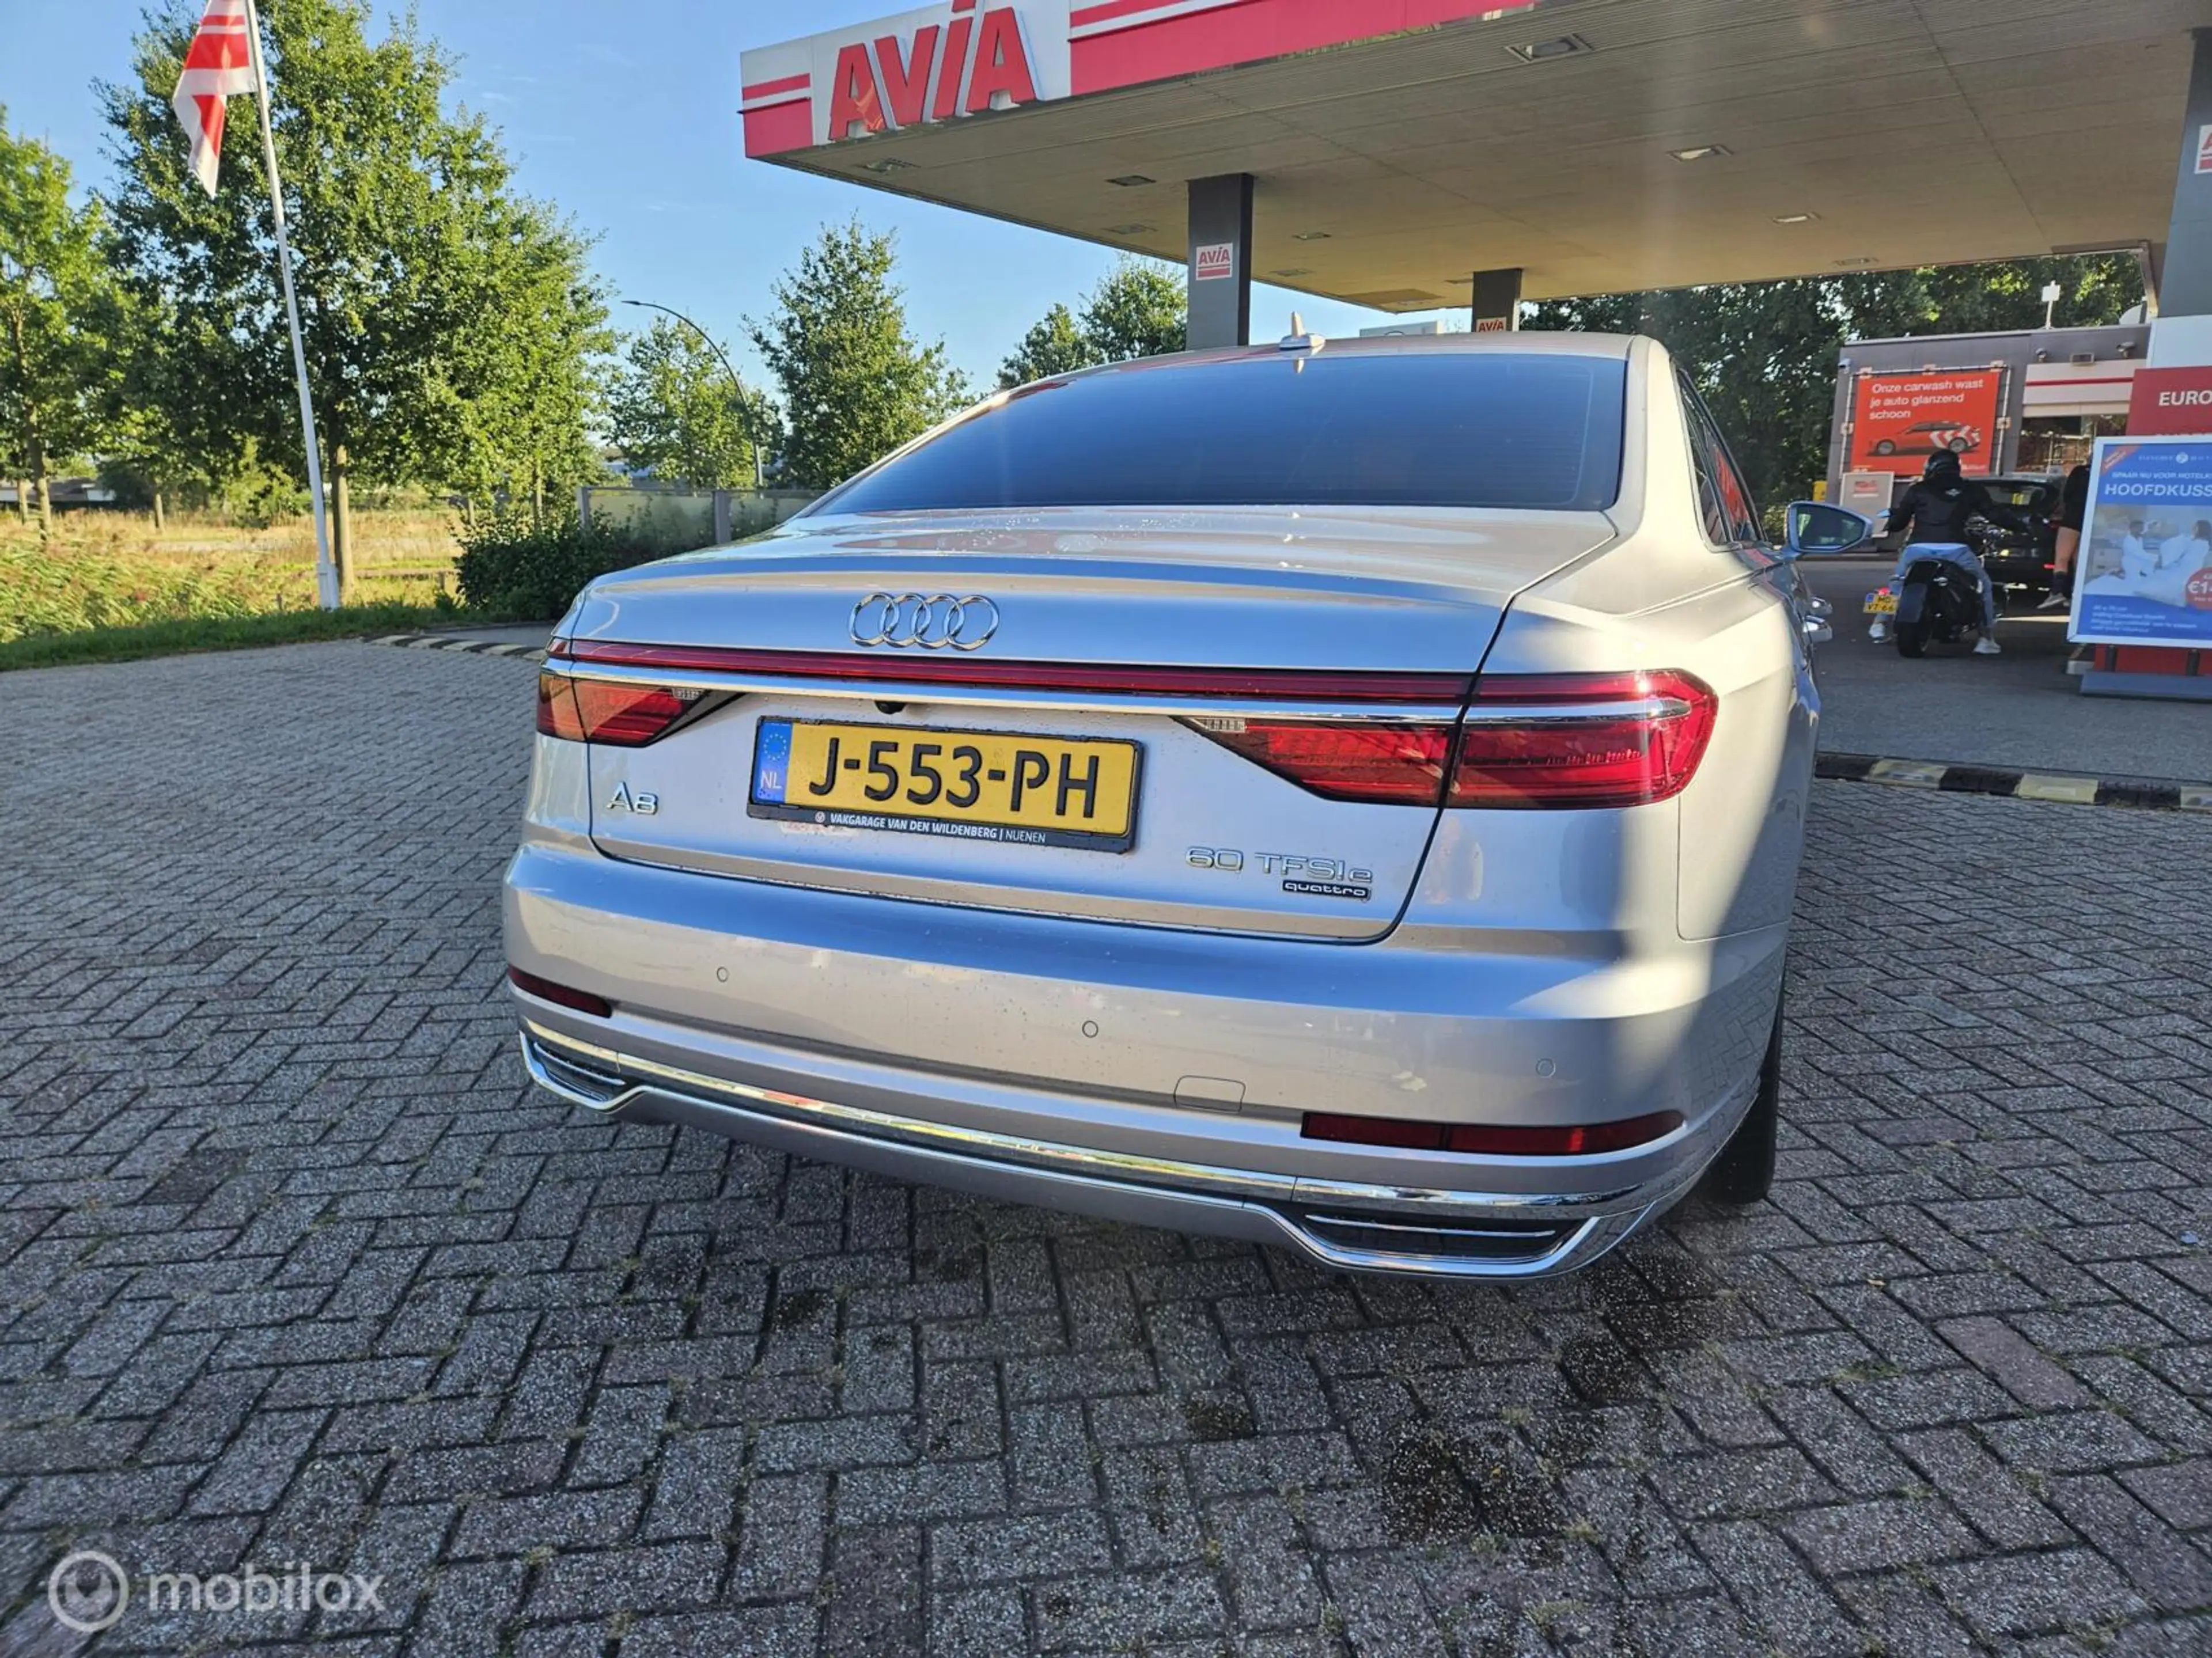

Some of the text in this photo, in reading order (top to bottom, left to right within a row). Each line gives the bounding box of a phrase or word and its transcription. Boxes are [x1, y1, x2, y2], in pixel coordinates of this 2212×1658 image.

[1872, 378, 1984, 394] Onze carwash wast
[1870, 393, 1965, 409] je auto glanzend
[2158, 390, 2212, 406] EURO
[1869, 409, 1911, 420] schoon
[760, 769, 782, 789] NL
[809, 737, 1100, 818] J-553-PH
[607, 781, 659, 815] A8
[830, 813, 885, 828] VAKGARAGE
[888, 818, 908, 830] VAN
[910, 820, 930, 832] DEN
[932, 822, 997, 839] WILDENBERG
[1005, 830, 1046, 843] NUENEN
[1185, 847, 1243, 871] 60
[1285, 882, 1366, 897] quattro
